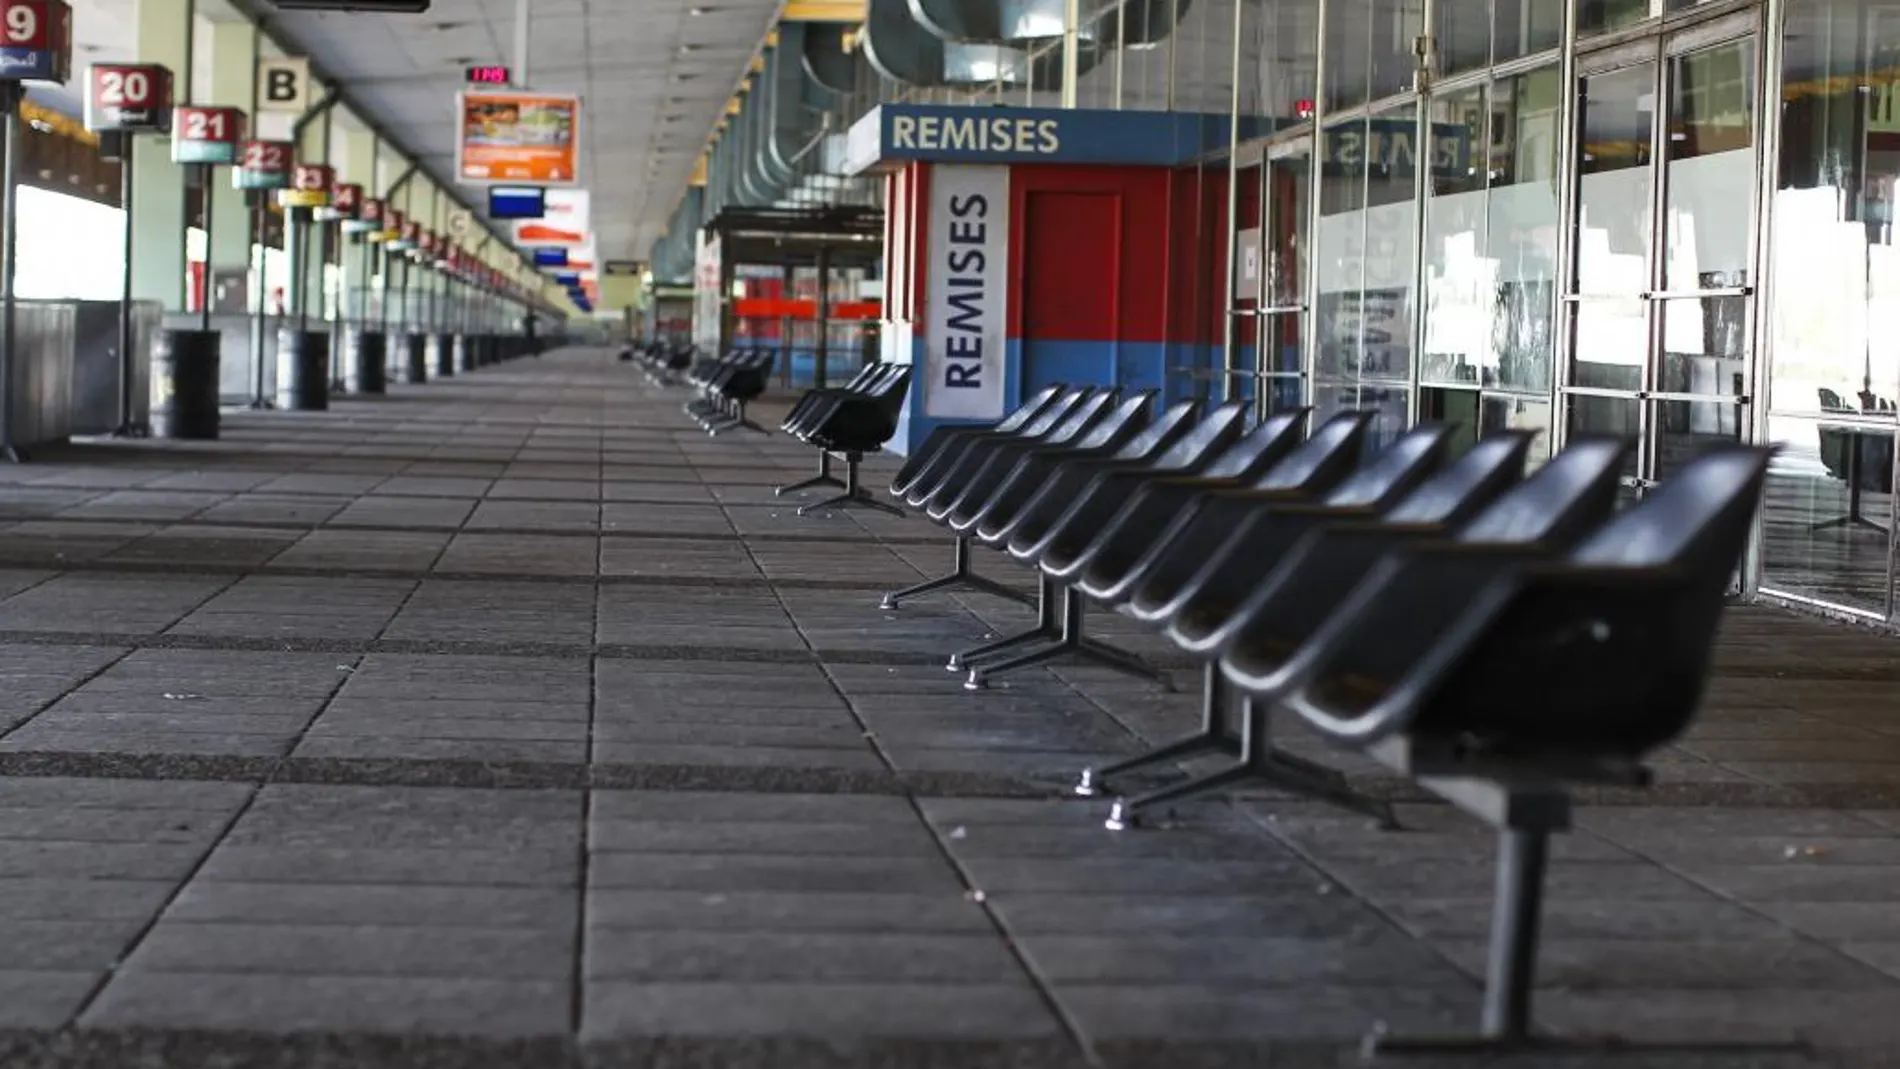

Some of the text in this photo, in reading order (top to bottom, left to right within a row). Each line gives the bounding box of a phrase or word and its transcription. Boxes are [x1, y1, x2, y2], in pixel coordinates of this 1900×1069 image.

[100, 72, 148, 103] 20
[267, 69, 297, 101] B
[187, 112, 225, 139] 21
[892, 115, 1060, 154] REMISES
[246, 143, 282, 168] 22
[945, 193, 988, 389] REMISES
